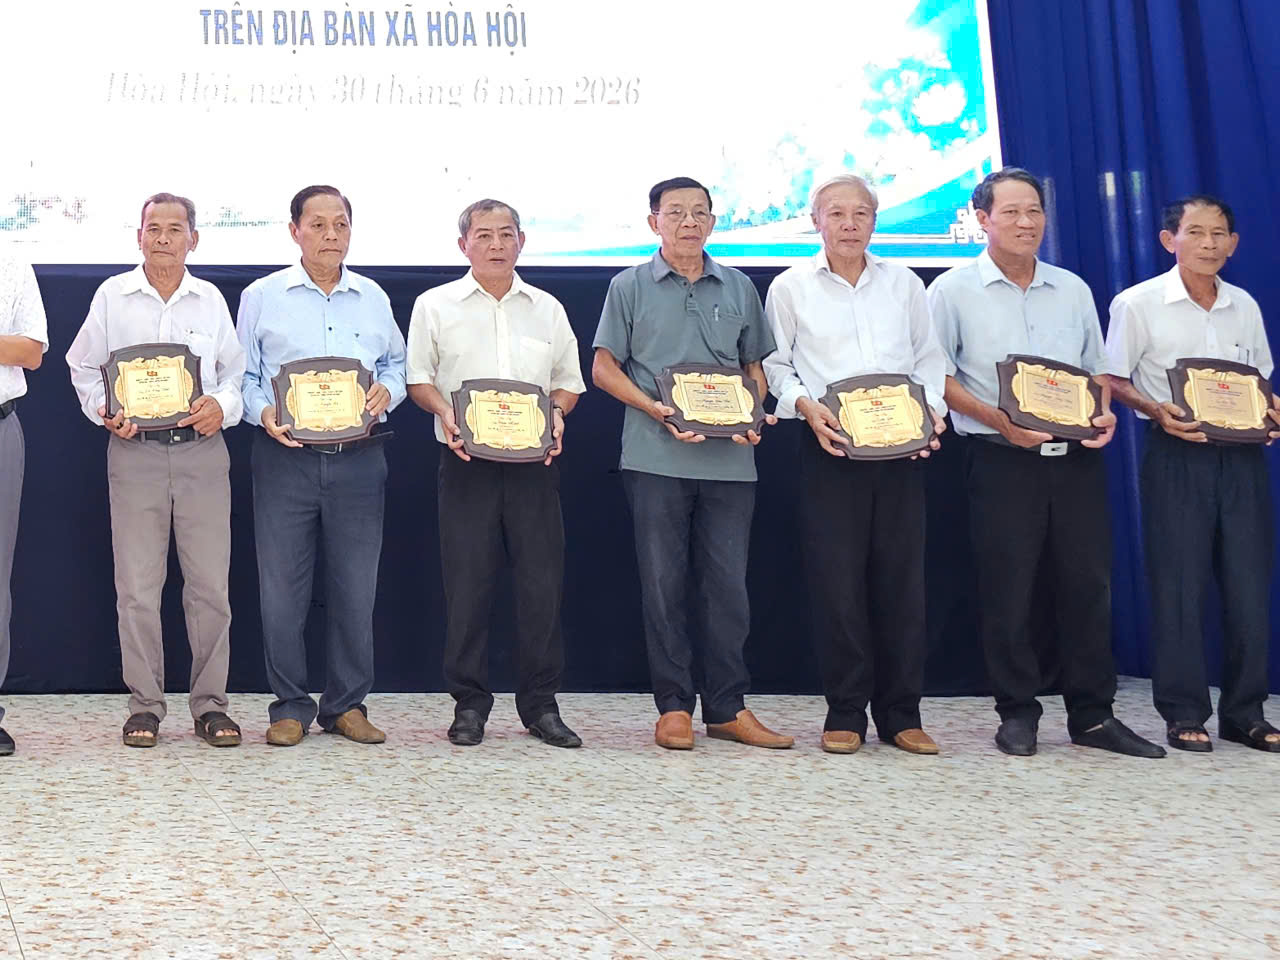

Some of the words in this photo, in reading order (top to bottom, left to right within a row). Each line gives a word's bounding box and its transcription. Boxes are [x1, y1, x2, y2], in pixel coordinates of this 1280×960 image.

[199, 0, 264, 45] TRÊN
[271, 9, 315, 54] ĐỊA
[323, 1, 376, 46] BÀN
[385, 3, 419, 47] XÃ
[426, 1, 478, 47] HÒA
[485, 3, 527, 56] HỘI
[332, 74, 367, 104] 30
[473, 75, 489, 104] 6
[573, 75, 641, 105] 2026
